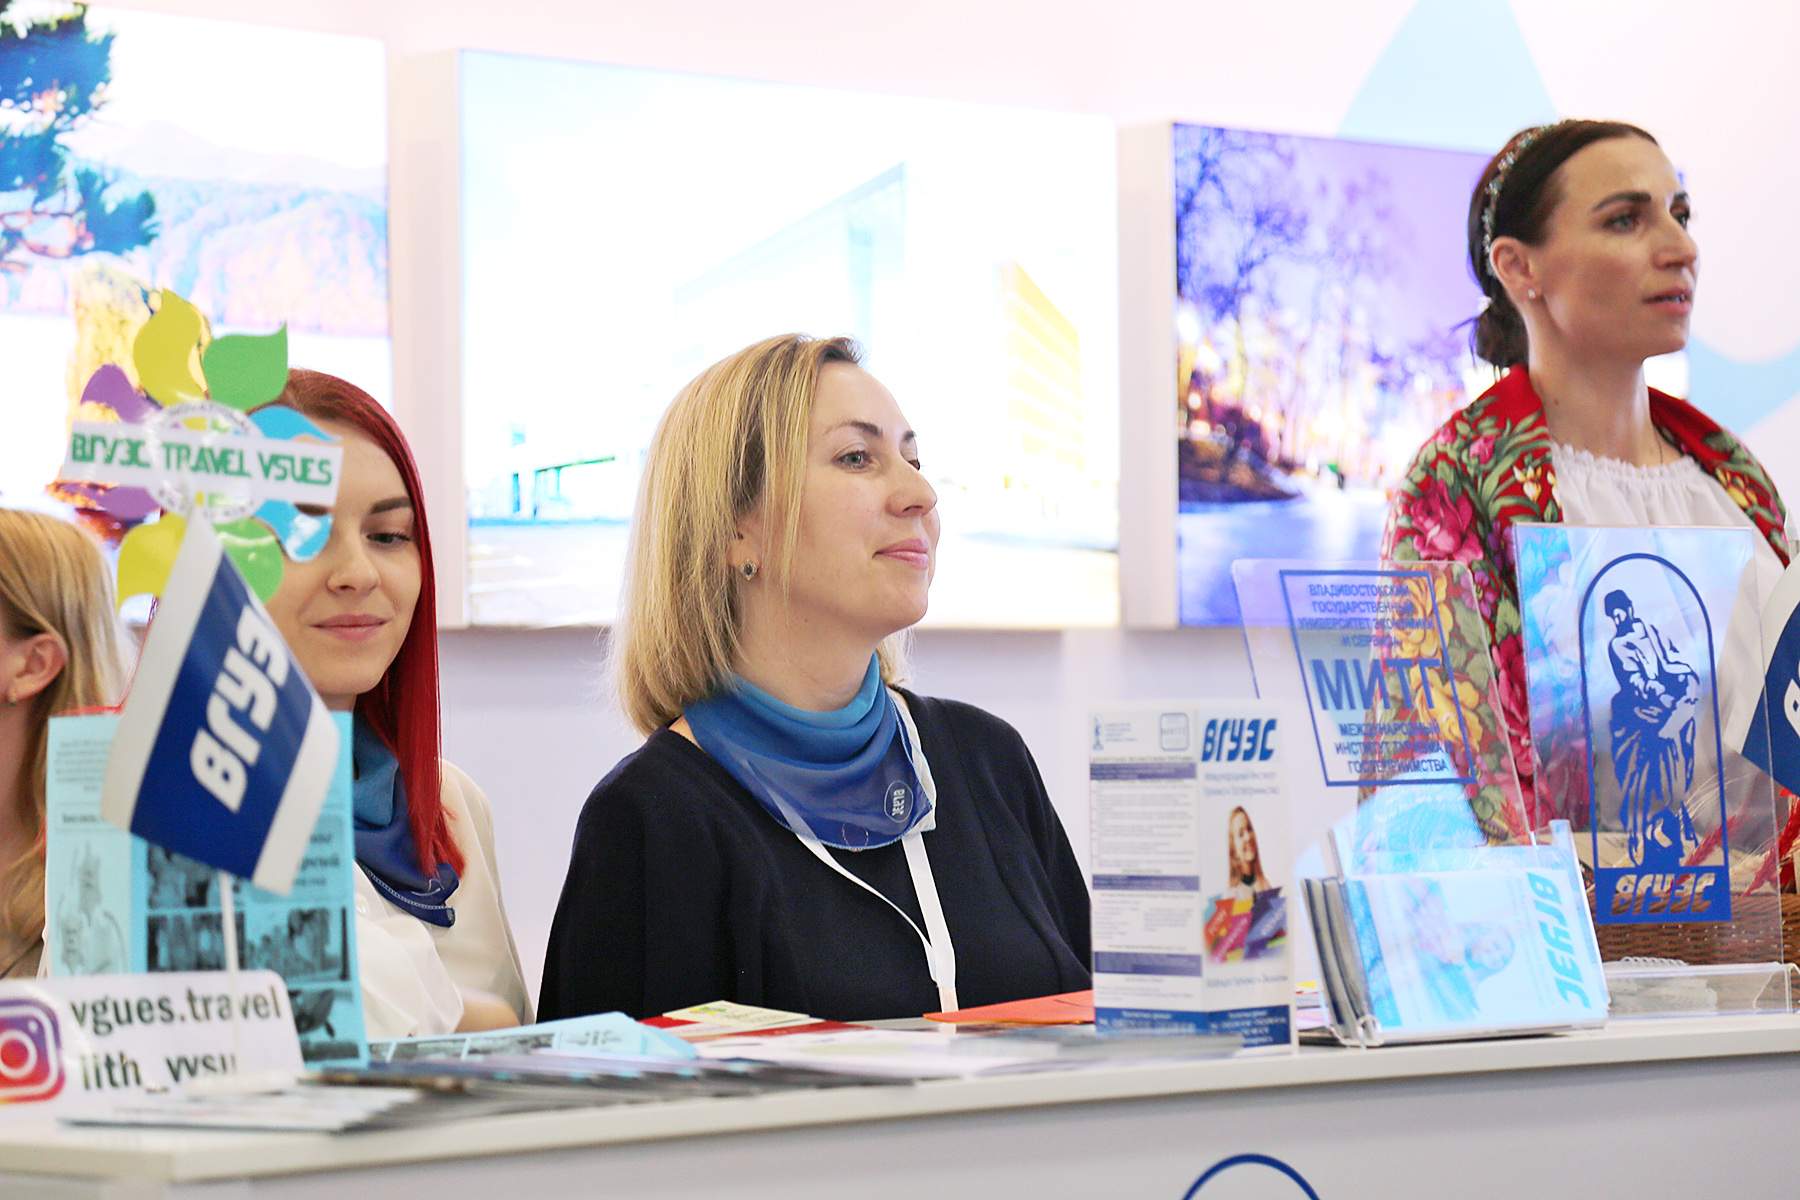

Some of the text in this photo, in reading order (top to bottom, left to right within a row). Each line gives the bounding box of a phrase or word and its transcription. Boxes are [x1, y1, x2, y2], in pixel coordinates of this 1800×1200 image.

[162, 442, 251, 478] TRAVEL
[258, 453, 332, 486] VSUES
[1311, 658, 1440, 710] МИТГ
[1200, 718, 1278, 763] ВГУЭС
[1611, 872, 1716, 916] ВГУЭС
[1527, 872, 1592, 1009] ВГУЭС
[70, 984, 282, 1036] vgues.travel
